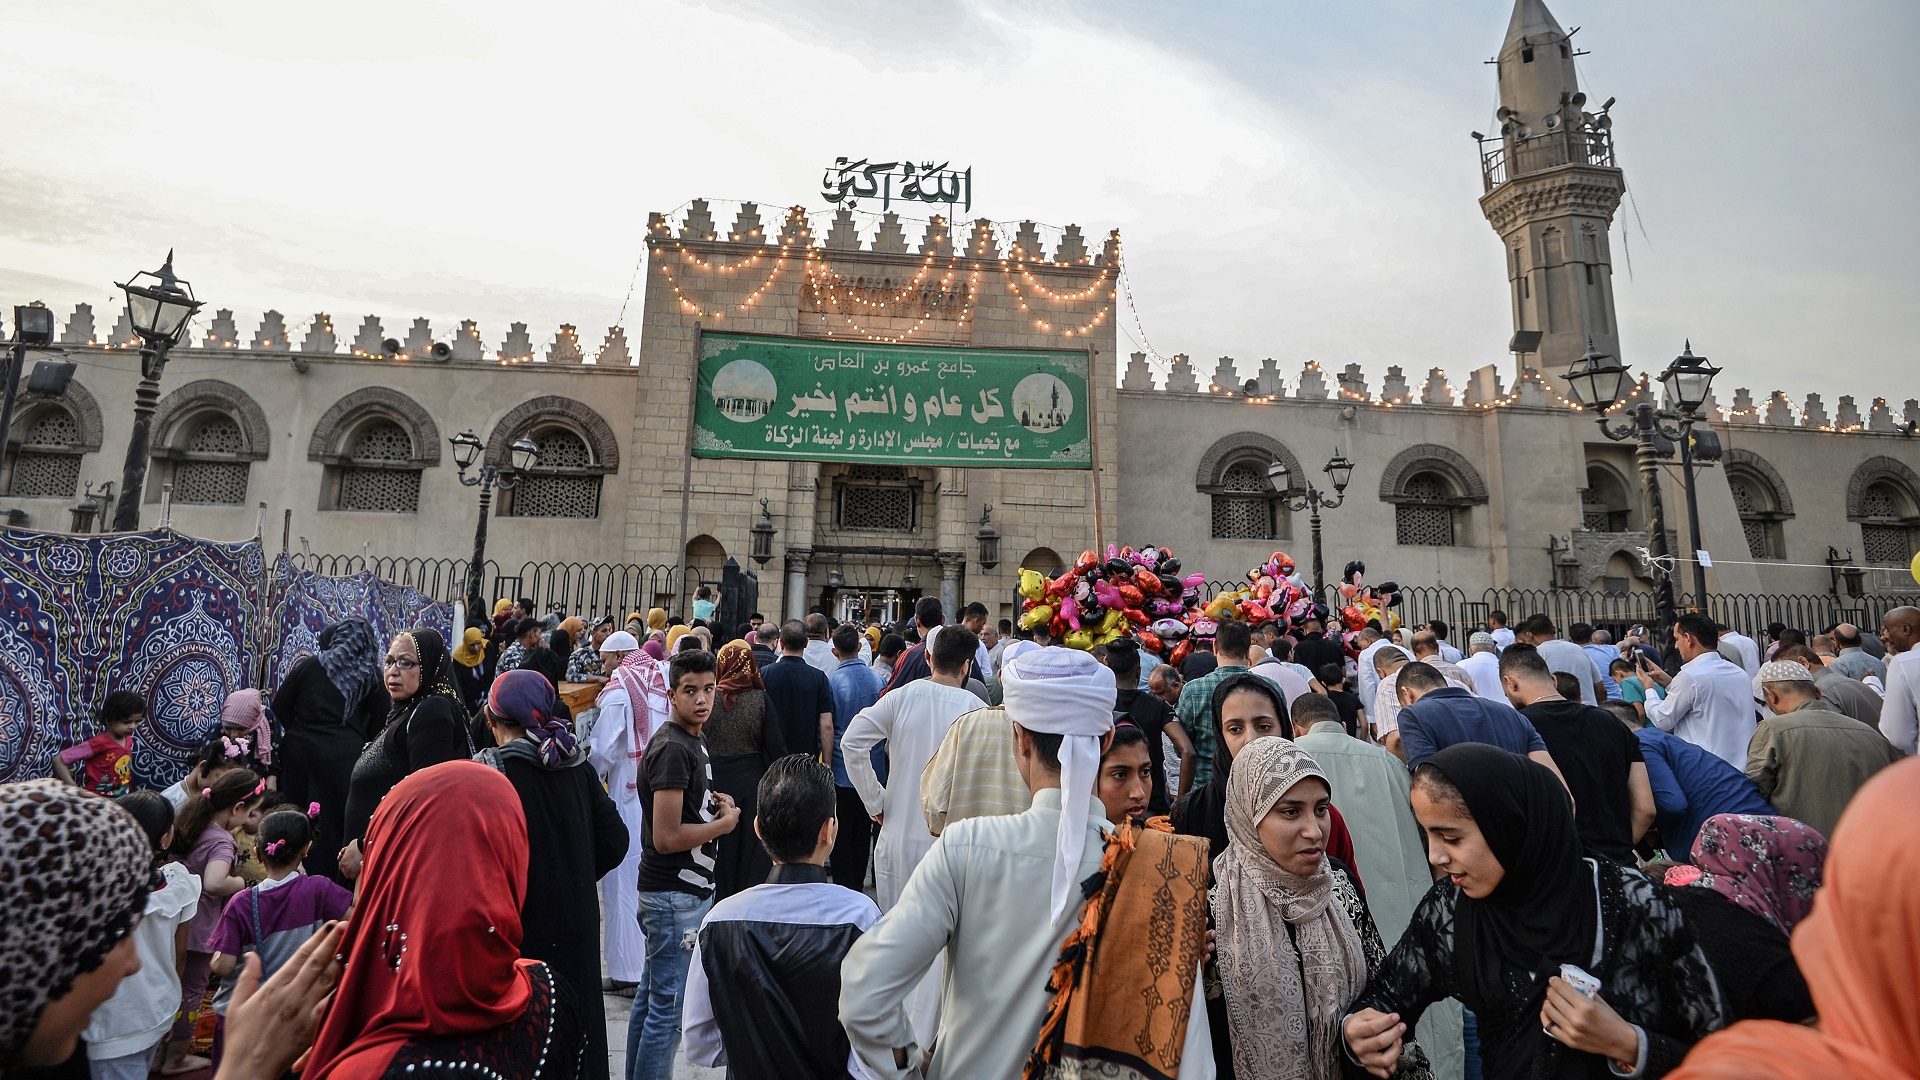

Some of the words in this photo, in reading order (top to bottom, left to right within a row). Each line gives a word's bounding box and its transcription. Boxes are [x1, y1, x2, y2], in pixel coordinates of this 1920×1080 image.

[814, 350, 865, 371] العاص
[872, 358, 889, 376] بن
[897, 359, 930, 376] عمرو
[937, 356, 976, 379] جامع
[786, 381, 837, 419] بخير
[845, 384, 897, 423] انتم
[903, 392, 917, 422] و
[923, 387, 962, 426] عام
[971, 388, 1004, 424] كل
[765, 424, 808, 448] الزكاة
[812, 424, 844, 449] لجنة
[858, 428, 901, 452] الإدارة
[903, 432, 943, 453] مجلس
[957, 431, 1000, 455] تحيات
[1004, 437, 1020, 457] مع
